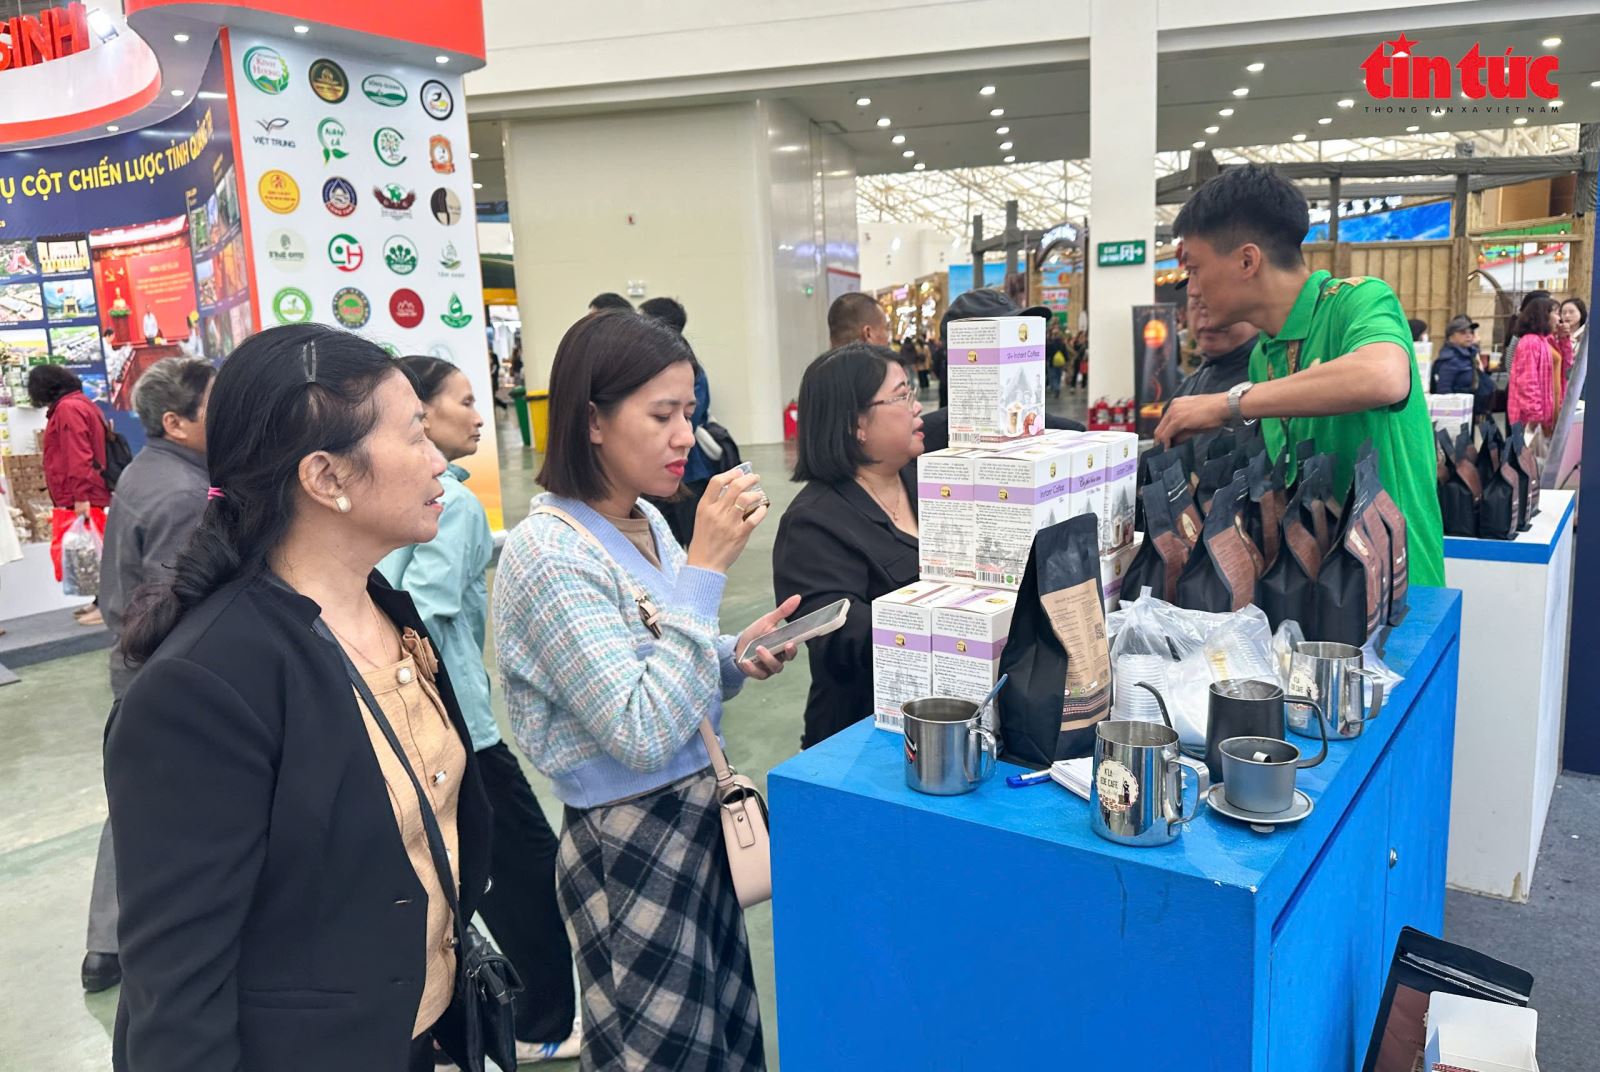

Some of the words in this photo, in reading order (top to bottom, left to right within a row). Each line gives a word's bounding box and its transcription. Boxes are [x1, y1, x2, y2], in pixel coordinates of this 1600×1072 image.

[21, 168, 63, 201] CỘT
[68, 156, 122, 191] CHIẾN
[124, 152, 165, 184] LƯỢC
[165, 139, 189, 171] TỈNH
